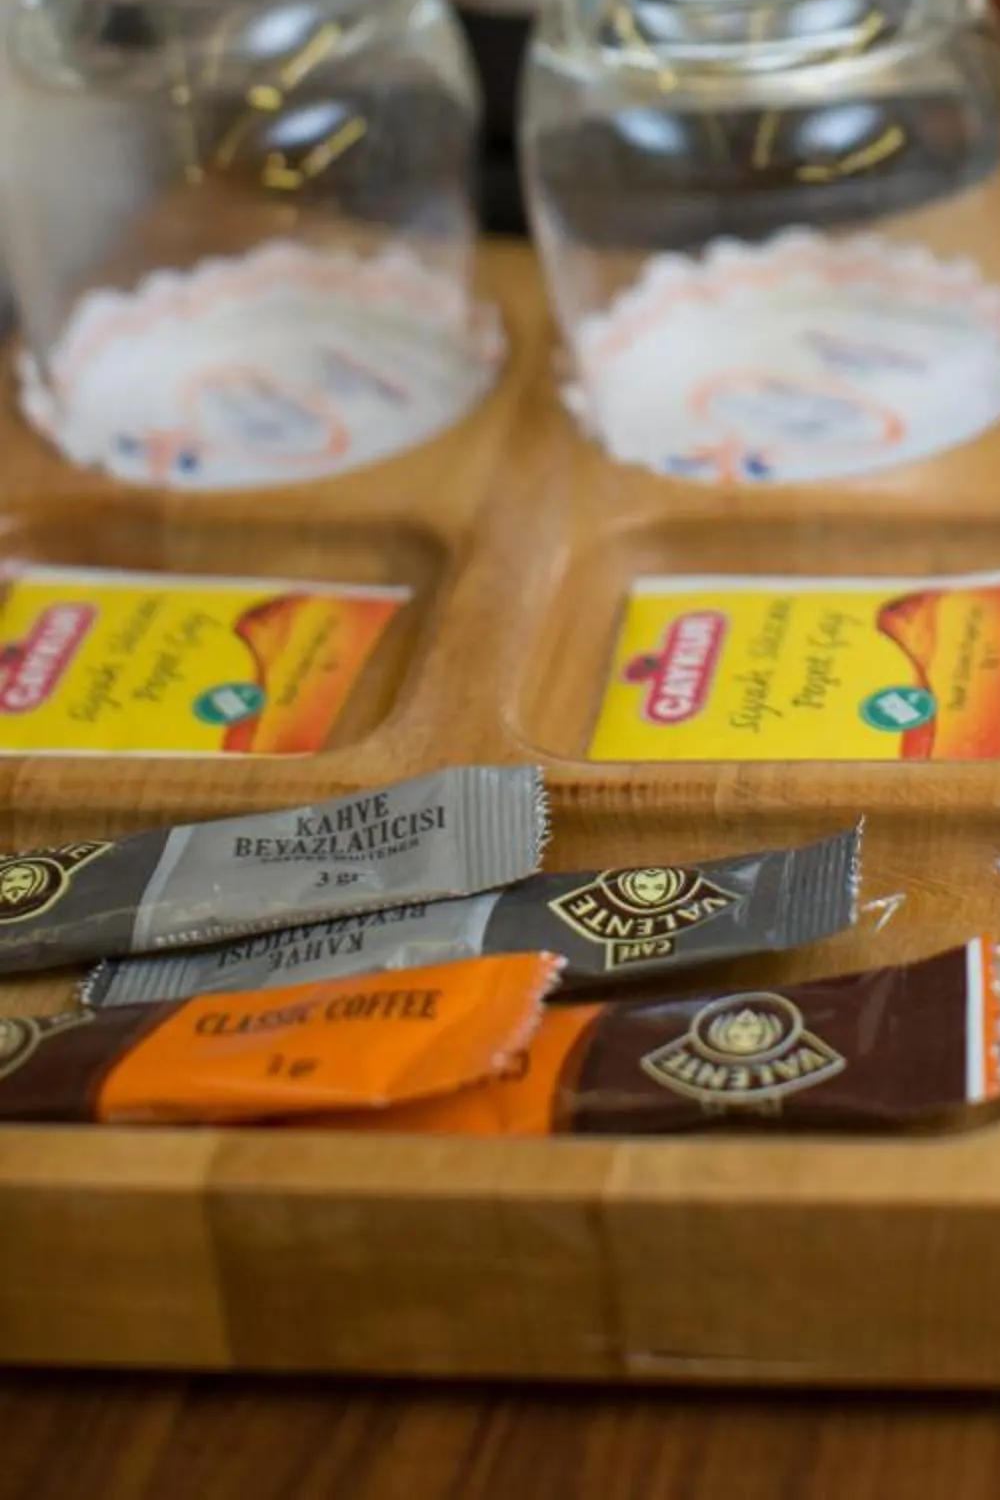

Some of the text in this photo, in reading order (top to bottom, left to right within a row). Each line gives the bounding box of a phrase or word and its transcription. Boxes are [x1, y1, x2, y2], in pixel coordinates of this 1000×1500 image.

[234, 806, 446, 857] BEYAZLATICISI
[295, 792, 390, 837] KAHVE
[314, 871, 329, 888] 3
[569, 894, 729, 937] VALENTE
[267, 930, 365, 972] KAHVE
[324, 988, 443, 1022] COFFEE
[661, 1047, 829, 1090] VALENTE
